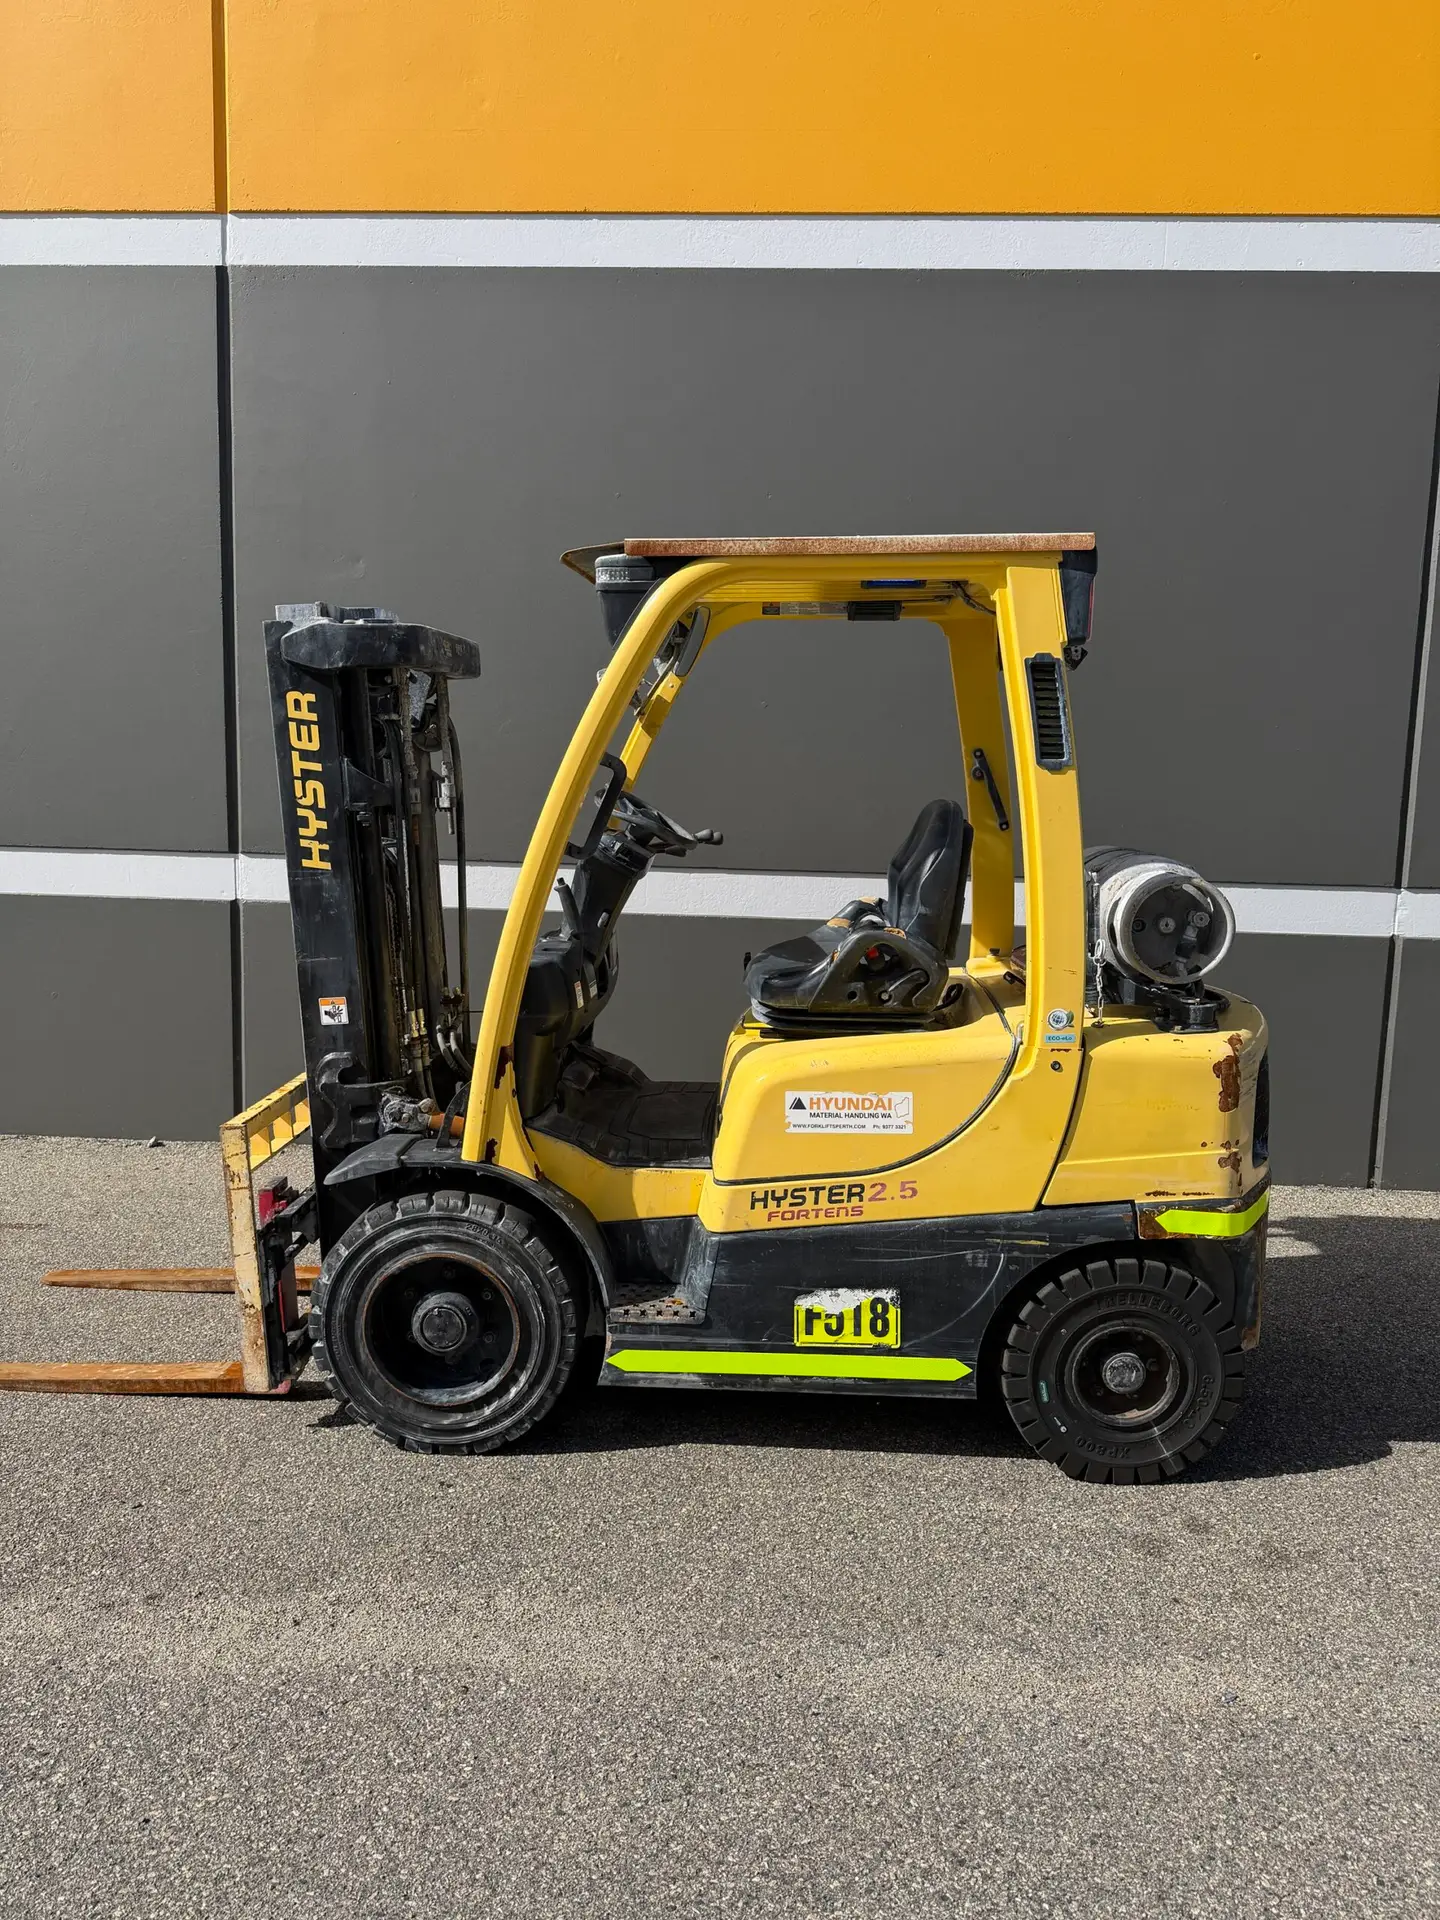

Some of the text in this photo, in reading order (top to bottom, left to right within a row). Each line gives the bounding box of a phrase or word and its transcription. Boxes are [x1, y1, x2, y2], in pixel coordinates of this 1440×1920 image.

[286, 690, 332, 871] HYSTER
[809, 1096, 893, 1111] HYUNDAI
[750, 1180, 918, 1210] HYSTER 2.5
[767, 1205, 864, 1222] FORTENS
